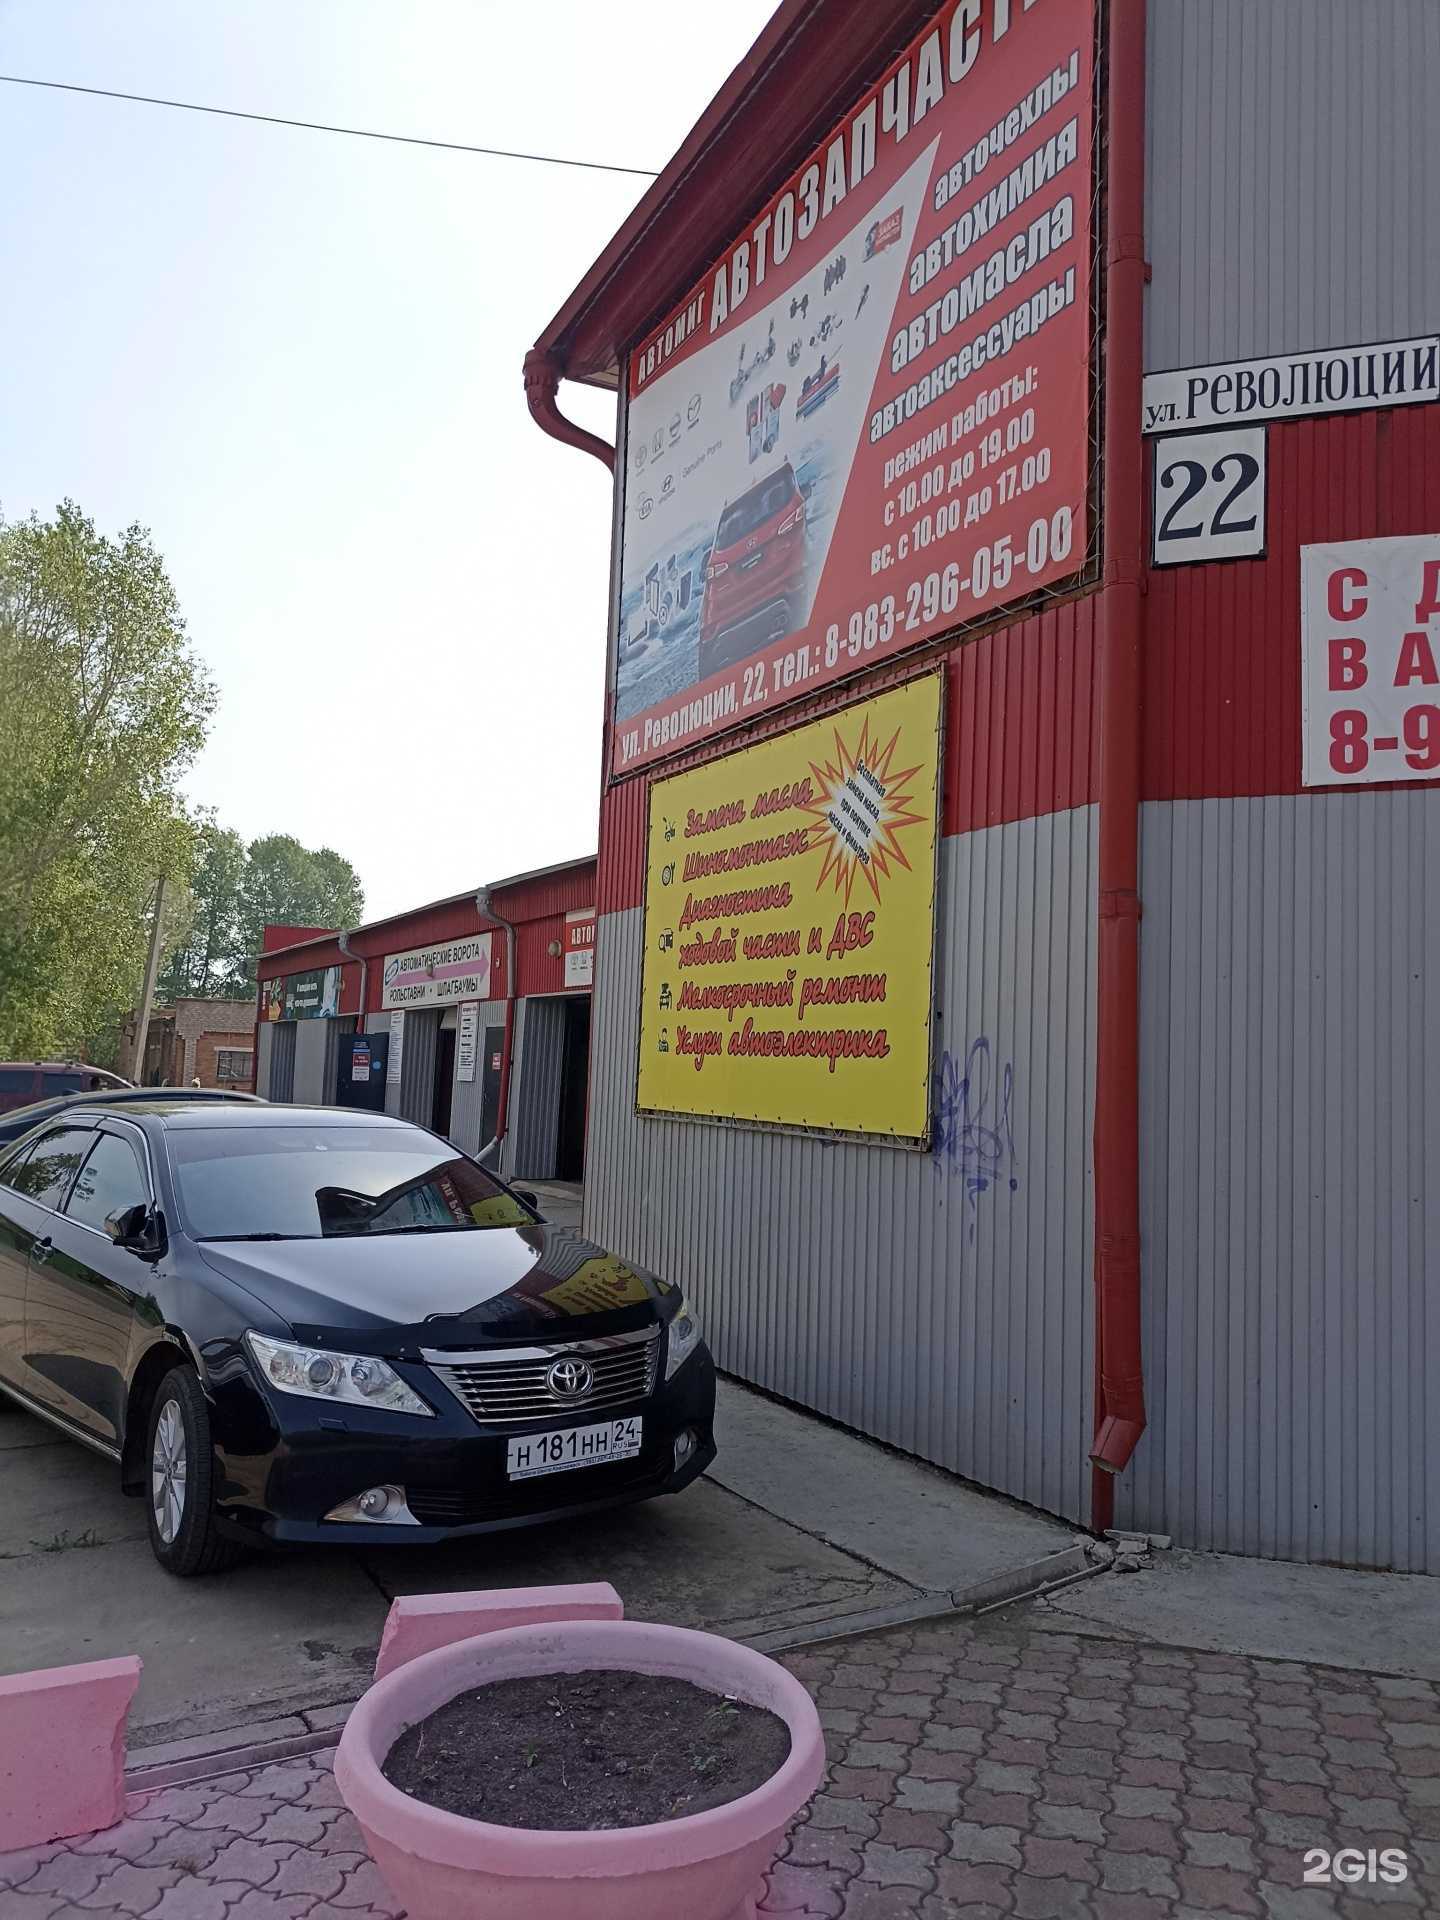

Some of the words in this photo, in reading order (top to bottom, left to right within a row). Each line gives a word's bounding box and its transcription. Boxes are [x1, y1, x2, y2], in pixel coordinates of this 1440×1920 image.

[935, 49, 1080, 211] авточехлы
[909, 116, 1078, 295] автохимия
[890, 196, 1074, 374] автомасла
[870, 266, 1076, 444] автоаксессуары
[883, 429, 949, 488] режим
[951, 367, 1039, 456] работы:
[1145, 403, 1183, 429] ул.
[883, 503, 894, 527] с
[898, 468, 944, 517] 10.00
[947, 456, 974, 490] до
[978, 408, 1036, 466] 19.00
[1158, 452, 1260, 542] 22
[871, 545, 895, 576] вс.
[898, 531, 909, 557] с
[913, 502, 961, 549] 10.00
[964, 490, 991, 529] до
[998, 447, 1052, 505] 17.00
[621, 735, 642, 765] ул.
[644, 682, 739, 750] Революции,
[743, 661, 768, 706] 22,
[773, 644, 821, 692] тел.:
[825, 505, 1074, 669] 8-983-296-05-00
[684, 799, 746, 838] Замена
[751, 777, 813, 819] масла
[682, 828, 809, 883] Шиномонтаж
[679, 882, 793, 931] Диагностика
[400, 949, 452, 971] АВТОМАТИЧЕСКИЕ
[453, 943, 480, 962] ВОРОТА
[678, 926, 739, 969] ходовой
[743, 929, 801, 961] части
[807, 926, 823, 954] и
[826, 910, 876, 961] ДВС
[390, 985, 426, 1002] РОЛЬСТАВНИ
[437, 978, 479, 997] ШЛАГБАУМЫ
[676, 969, 797, 1021] Мелкосрочный
[799, 972, 887, 1020] ремонт
[676, 1025, 723, 1071] Услуги
[727, 1016, 891, 1074] автоэлектрика
[614, 1419, 635, 1442] 24
